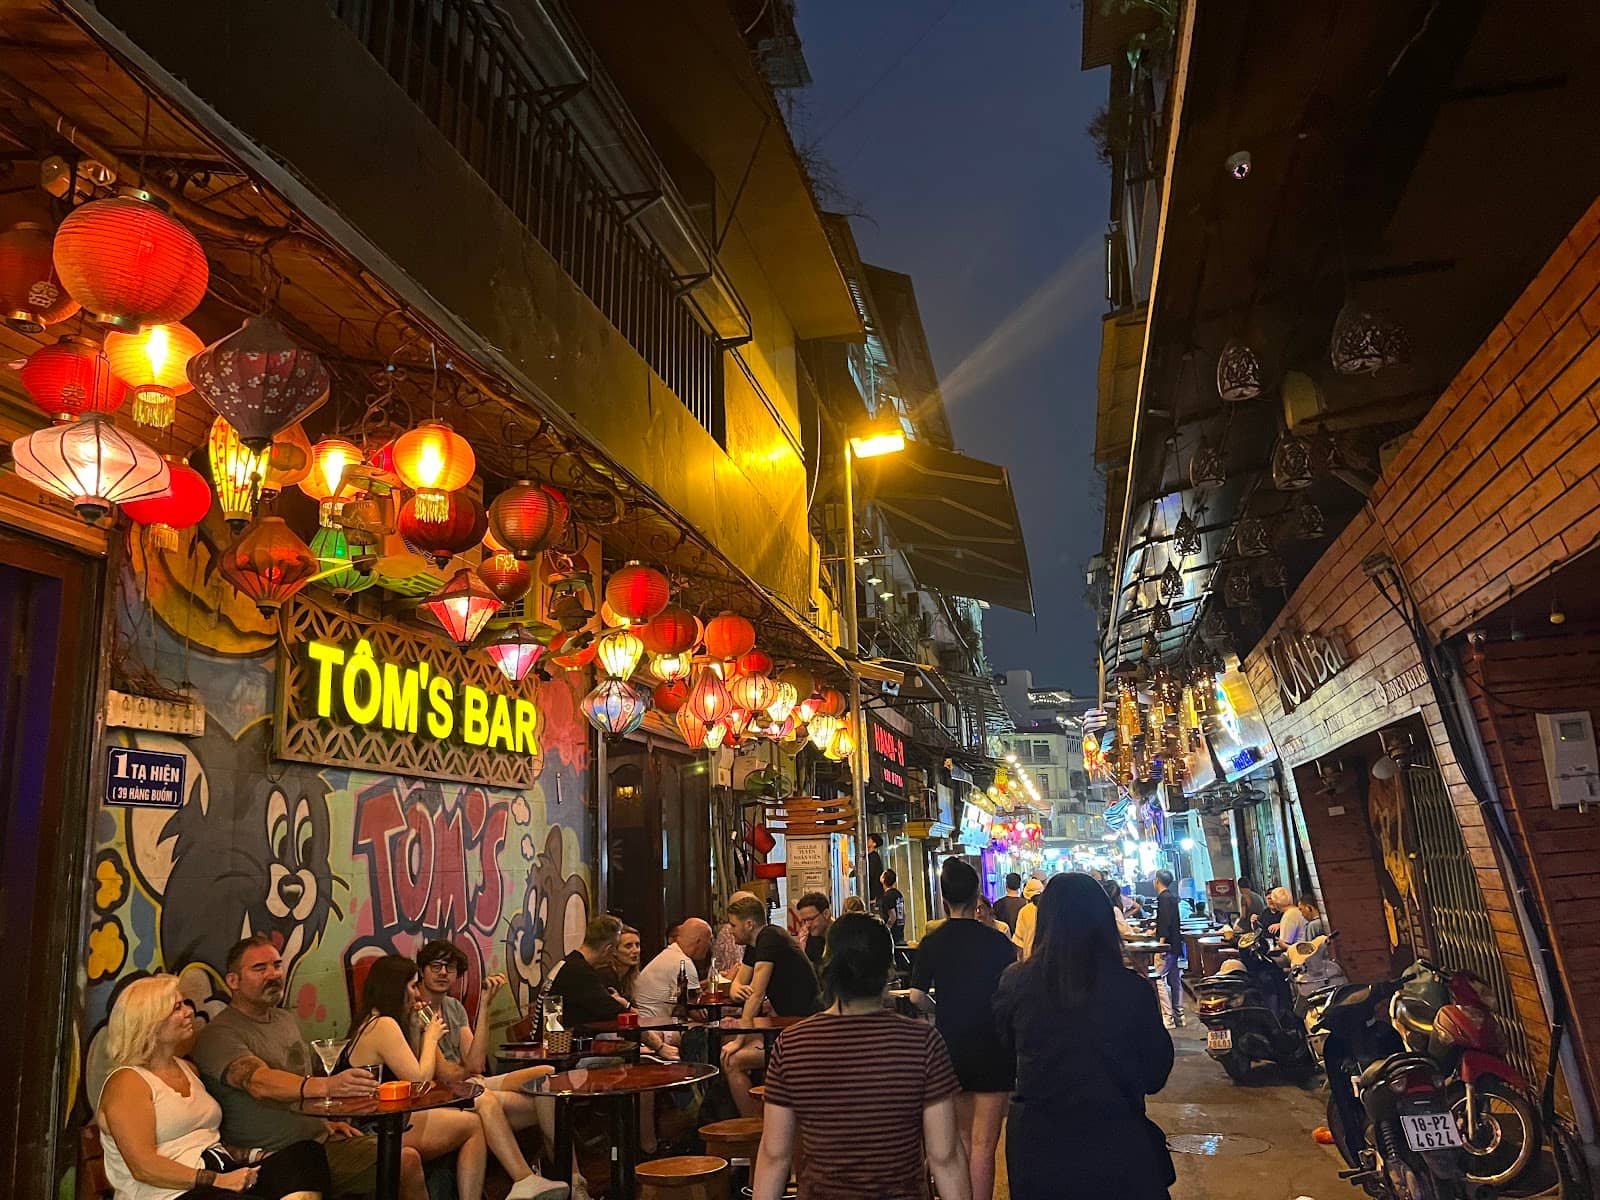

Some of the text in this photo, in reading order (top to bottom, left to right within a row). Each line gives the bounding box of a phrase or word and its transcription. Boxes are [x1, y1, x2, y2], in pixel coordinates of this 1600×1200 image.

[309, 639, 537, 755] TÔM'S BAR
[112, 753, 180, 785] 1 TẠ HIỆN
[129, 786, 150, 801] HÀNG
[1411, 1115, 1450, 1132] 18-P2
[1416, 1131, 1455, 1147] 4624
